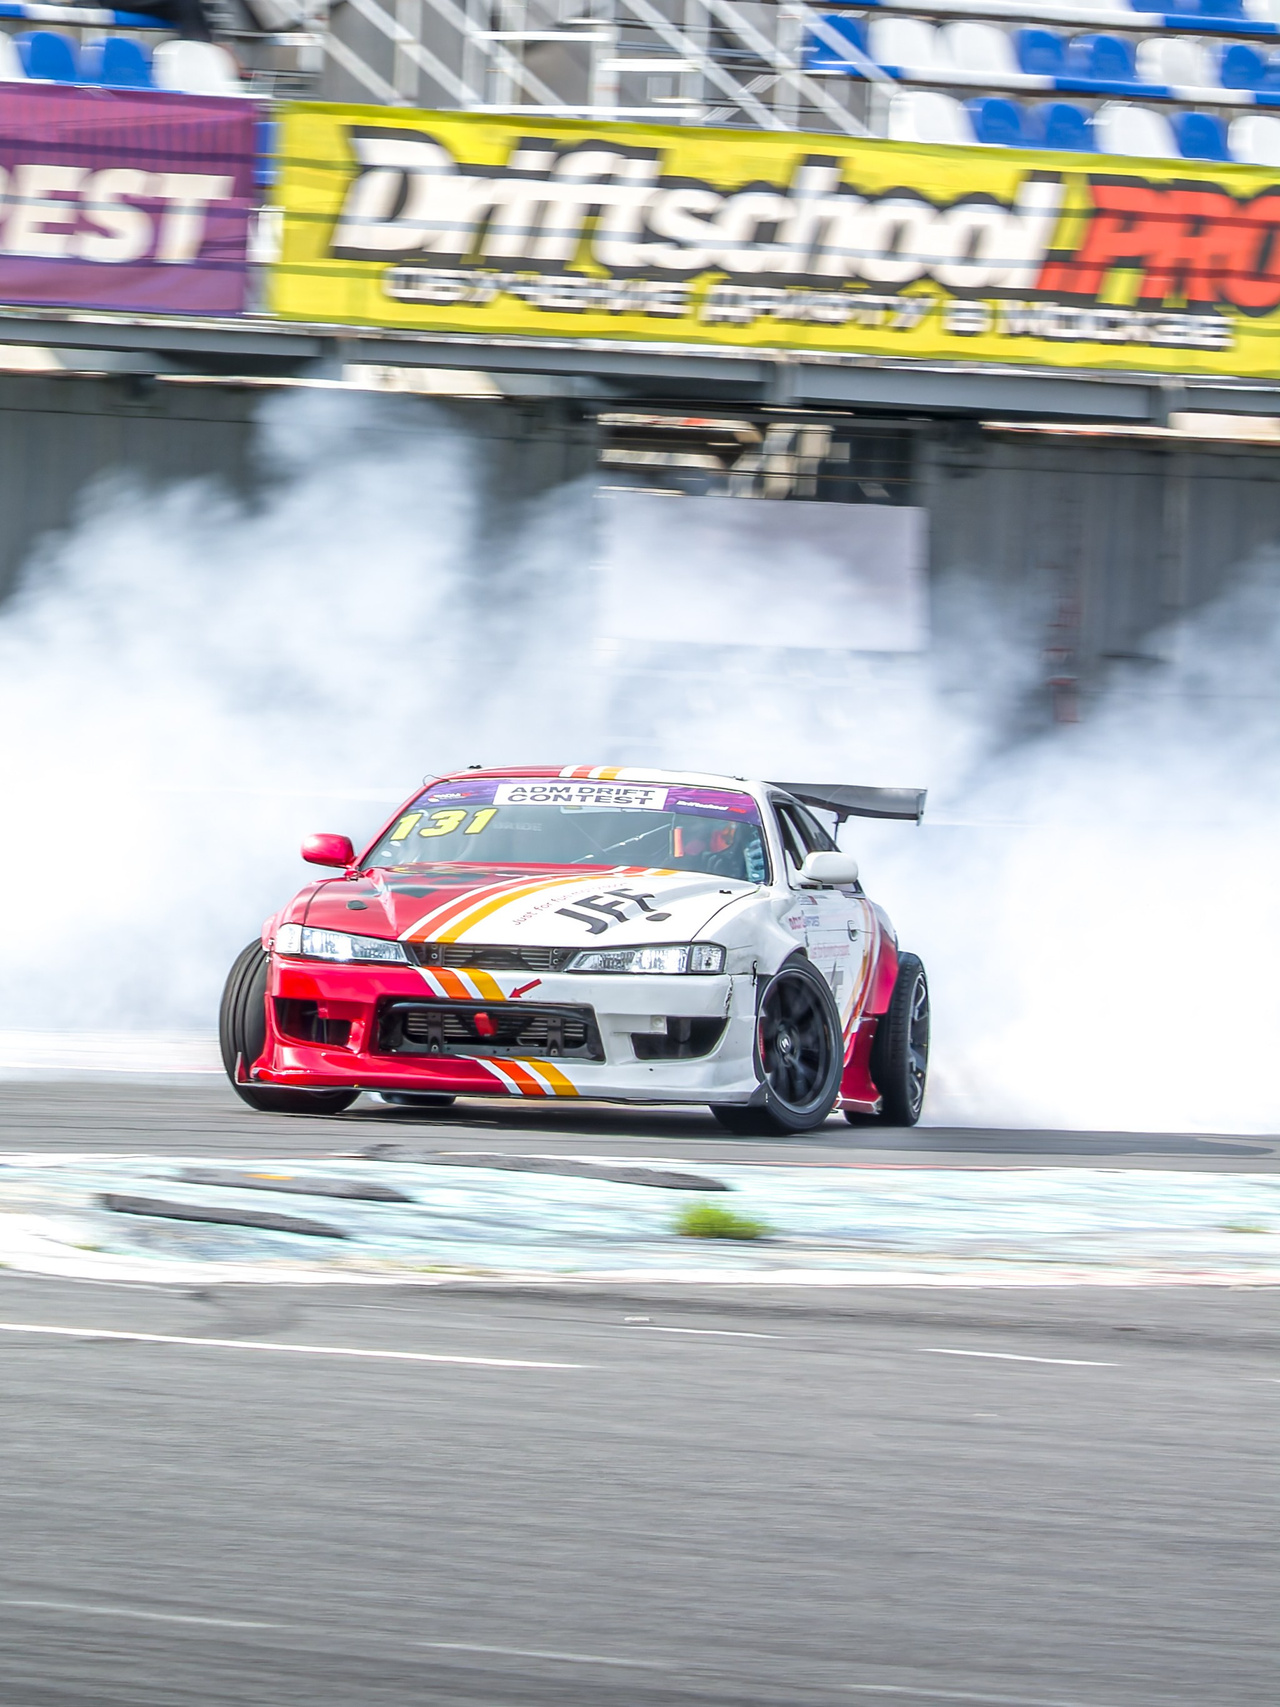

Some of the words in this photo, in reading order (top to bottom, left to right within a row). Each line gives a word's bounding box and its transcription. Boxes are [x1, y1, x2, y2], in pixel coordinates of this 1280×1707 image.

[510, 786, 572, 794] ADM
[577, 787, 656, 797] DRIFT
[507, 794, 654, 805] CONTEST
[390, 808, 498, 841] 131
